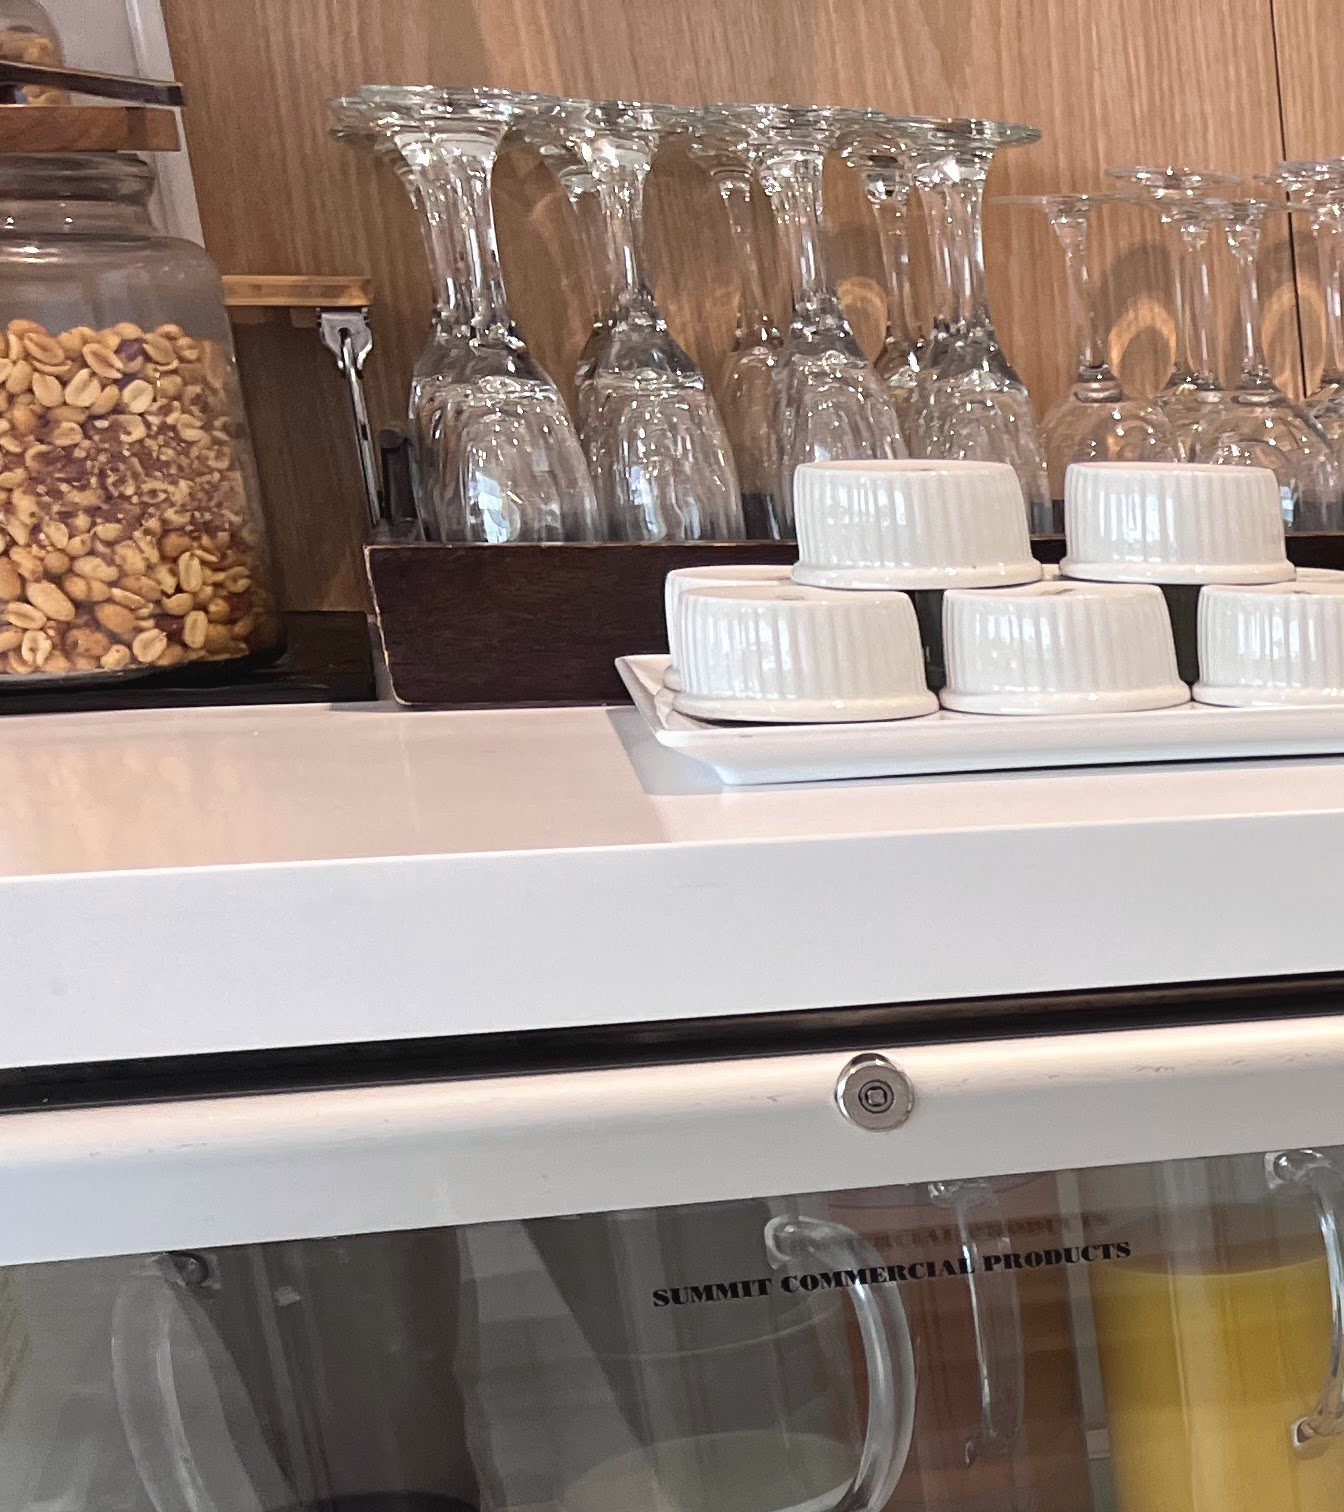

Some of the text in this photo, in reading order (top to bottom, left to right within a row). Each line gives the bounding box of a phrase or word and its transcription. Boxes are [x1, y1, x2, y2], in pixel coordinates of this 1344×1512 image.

[652, 1241, 1133, 1309] SUMMIT COMMERCIAL PRODUCTS
